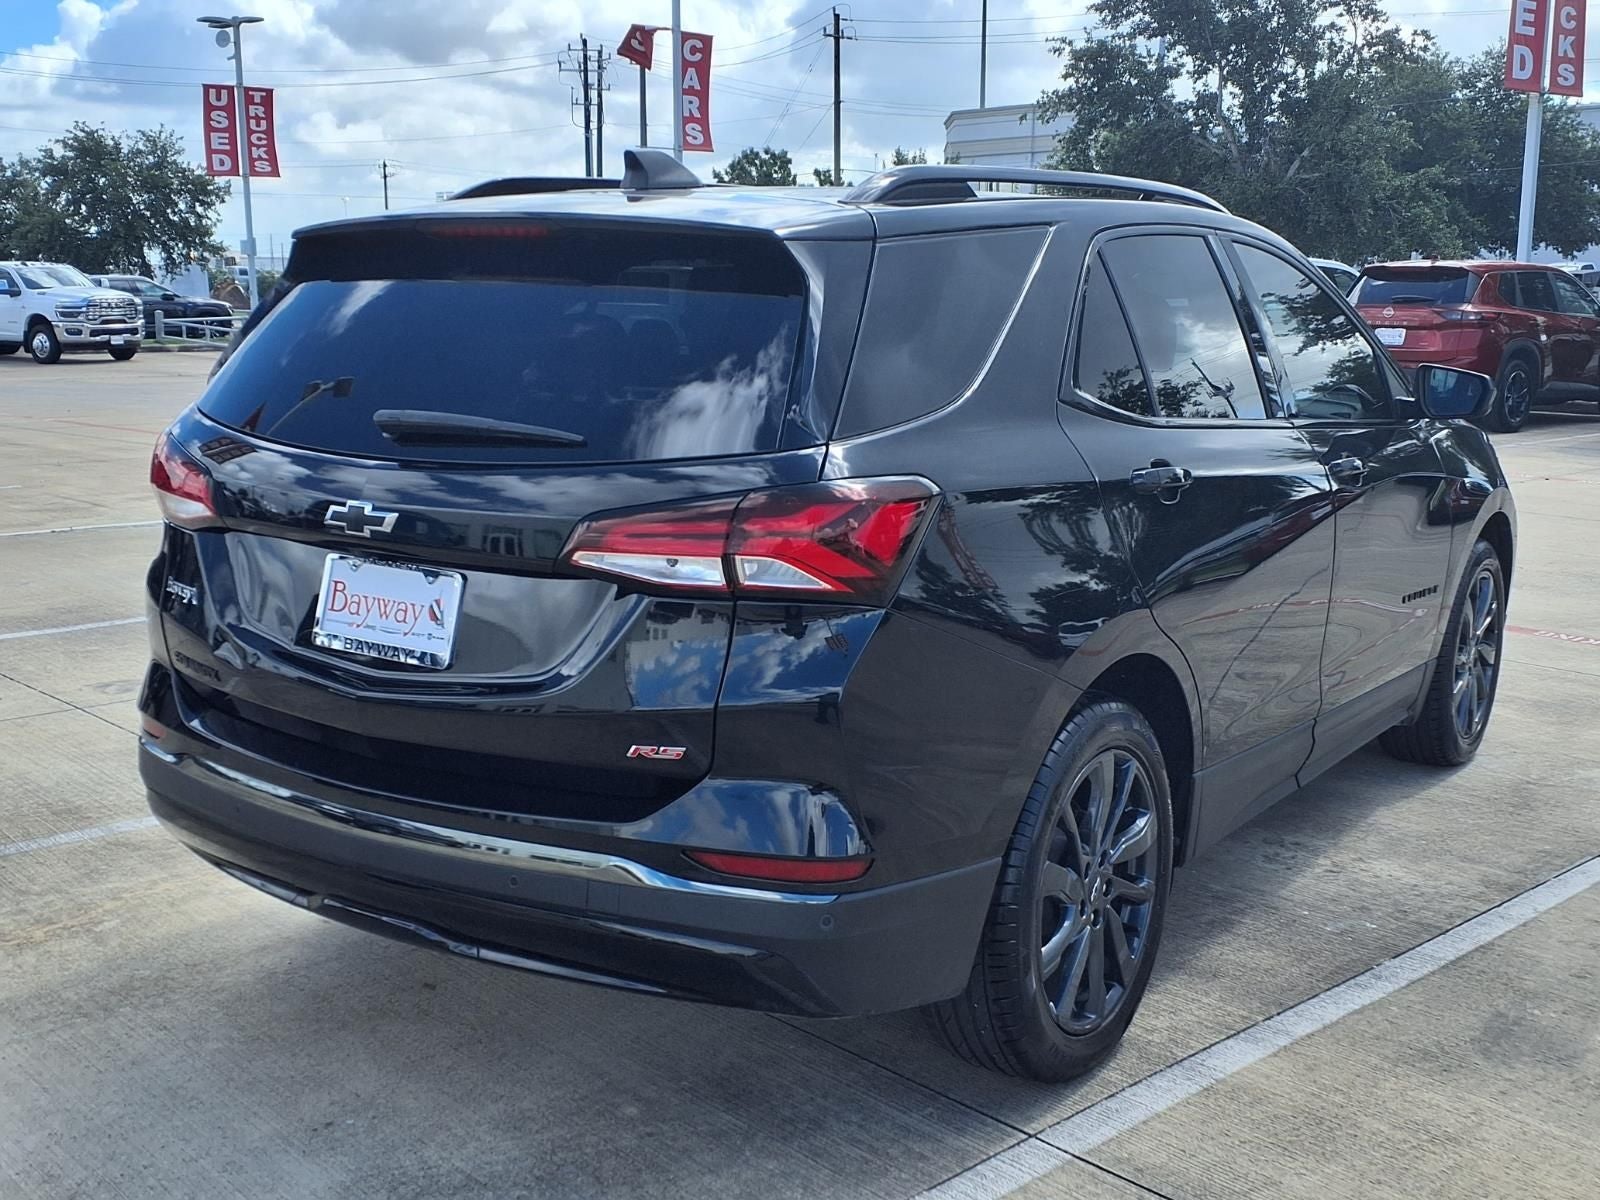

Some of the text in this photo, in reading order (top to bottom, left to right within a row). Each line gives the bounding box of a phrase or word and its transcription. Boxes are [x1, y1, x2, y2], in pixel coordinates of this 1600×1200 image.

[1511, 0, 1537, 80] ED
[1556, 6, 1577, 86] CKS
[208, 88, 232, 171] USED
[248, 90, 272, 173] TRUCKS
[682, 38, 705, 145] CARS
[328, 580, 424, 637] Bayway
[343, 636, 412, 662] BAYWAY
[626, 744, 687, 760] RS
